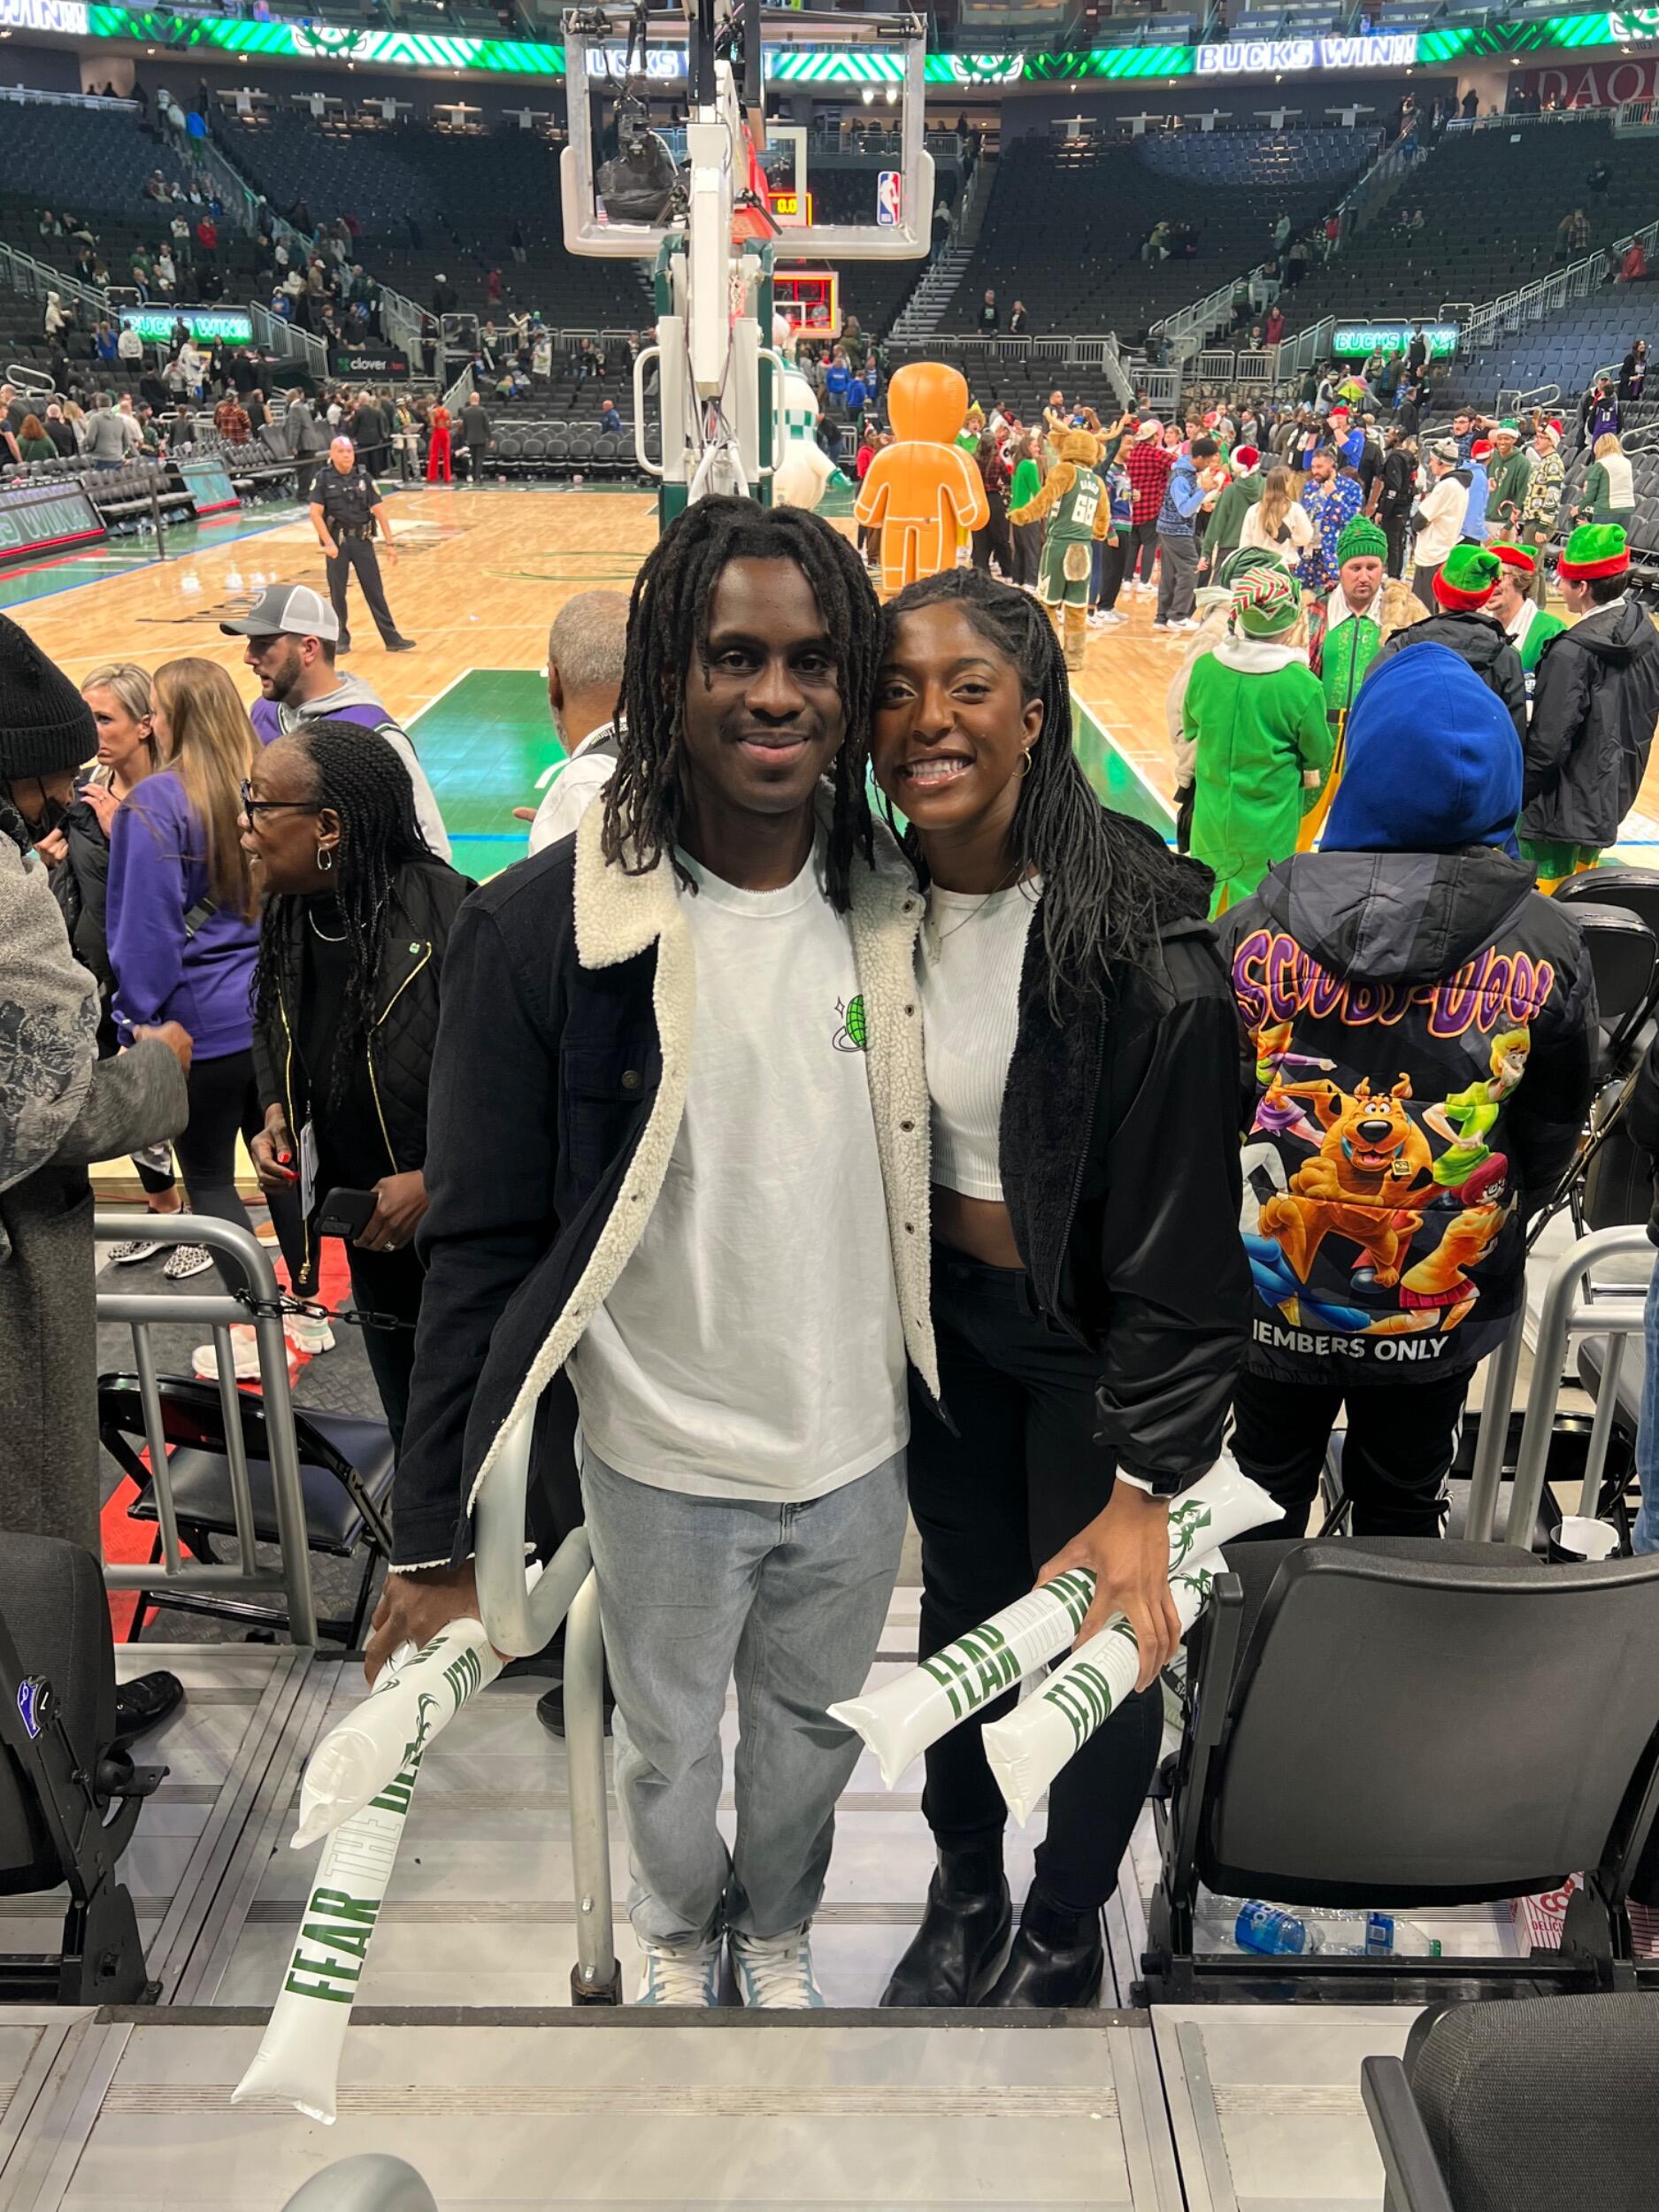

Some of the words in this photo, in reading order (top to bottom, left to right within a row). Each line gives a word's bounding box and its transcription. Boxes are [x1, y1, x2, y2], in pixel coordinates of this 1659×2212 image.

[587, 50, 679, 77] UCKS
[1196, 42, 1313, 73] BUCKS
[1321, 35, 1417, 67] WIN!!
[1538, 60, 1659, 106] DAQ
[1336, 332, 1400, 350] BUCKS
[349, 357, 388, 371] clover
[1253, 1318, 1365, 1358] EMBERS
[1374, 1335, 1450, 1362] ONLY
[324, 1817, 402, 1883] THE
[284, 1886, 381, 2004] FEAR
